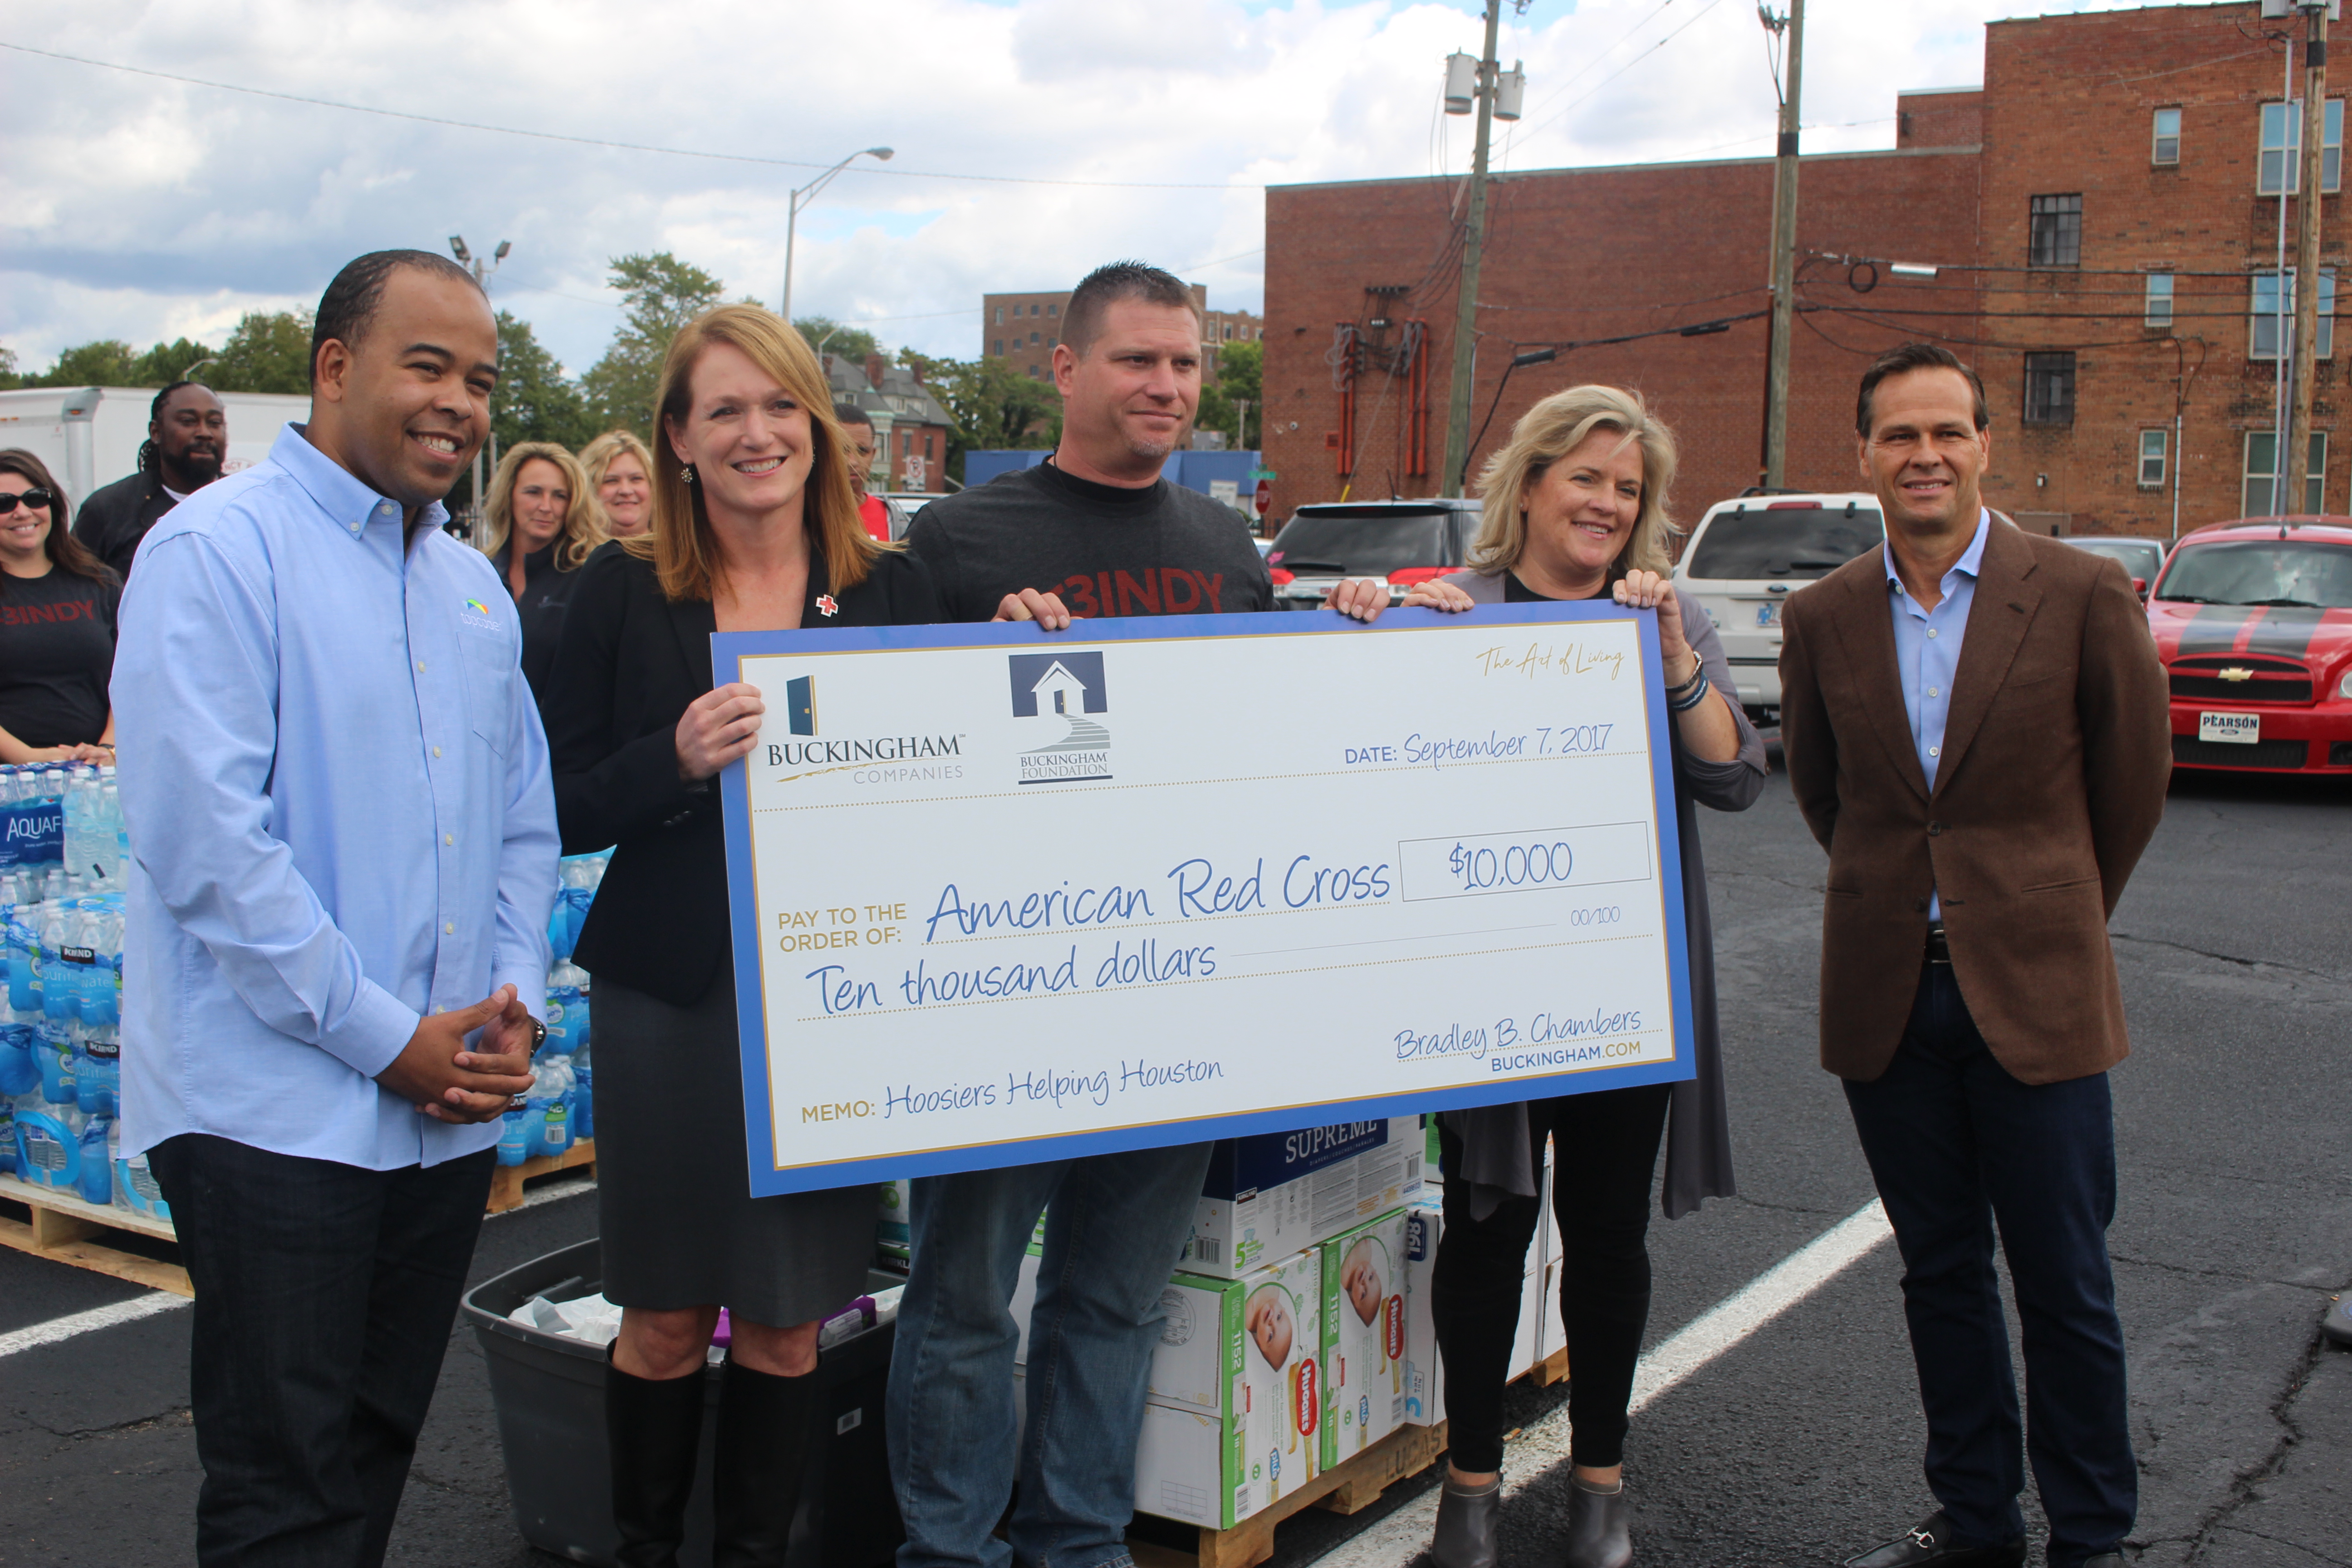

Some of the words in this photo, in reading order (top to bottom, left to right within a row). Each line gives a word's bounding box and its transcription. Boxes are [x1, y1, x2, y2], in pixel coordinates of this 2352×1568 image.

[1476, 646, 1513, 676] The
[1516, 642, 1553, 679] Art
[1559, 643, 1573, 675] of
[1576, 643, 1625, 680] Living
[2203, 714, 2258, 729] PEARSON
[768, 734, 960, 767] BUCKINGHAM
[1020, 752, 1107, 767] BUCKINGHAM
[1345, 745, 1398, 764] DATE:
[1404, 730, 1528, 771] September
[1537, 727, 1553, 755] 7,
[1560, 723, 1614, 754] 2017
[853, 765, 963, 784] COMPANIES
[1021, 763, 1107, 779] FOUNDATION
[1449, 841, 1573, 891] $10,000
[778, 910, 819, 930] PAY
[827, 907, 857, 925] TO
[864, 903, 907, 921] THE
[926, 883, 1155, 943] American
[1168, 858, 1266, 918] Red
[1283, 855, 1391, 908] Cross
[1571, 906, 1620, 927] 00/100
[780, 930, 859, 952] ORDER
[866, 926, 902, 945] OF:
[805, 965, 883, 1015] Ten
[899, 945, 1079, 1005] thousand
[1095, 938, 1216, 988] dollars
[1393, 1023, 1487, 1060] Bradley
[1494, 1018, 1523, 1047] B.
[1531, 1007, 1642, 1044] Chambers
[1491, 1040, 1641, 1072] BUCKINGHAM.COM
[802, 1100, 876, 1123] MEMO:
[884, 1084, 996, 1119] Hoosiers
[1006, 1069, 1109, 1109] Helping
[1118, 1059, 1225, 1092] Houston
[1330, 1293, 1338, 1335] 1152
[1389, 1299, 1399, 1356] HUGGIES
[1234, 1330, 1242, 1370] 1152
[1301, 1364, 1312, 1432] HUGGIES
[1270, 1451, 1280, 1480] plus
